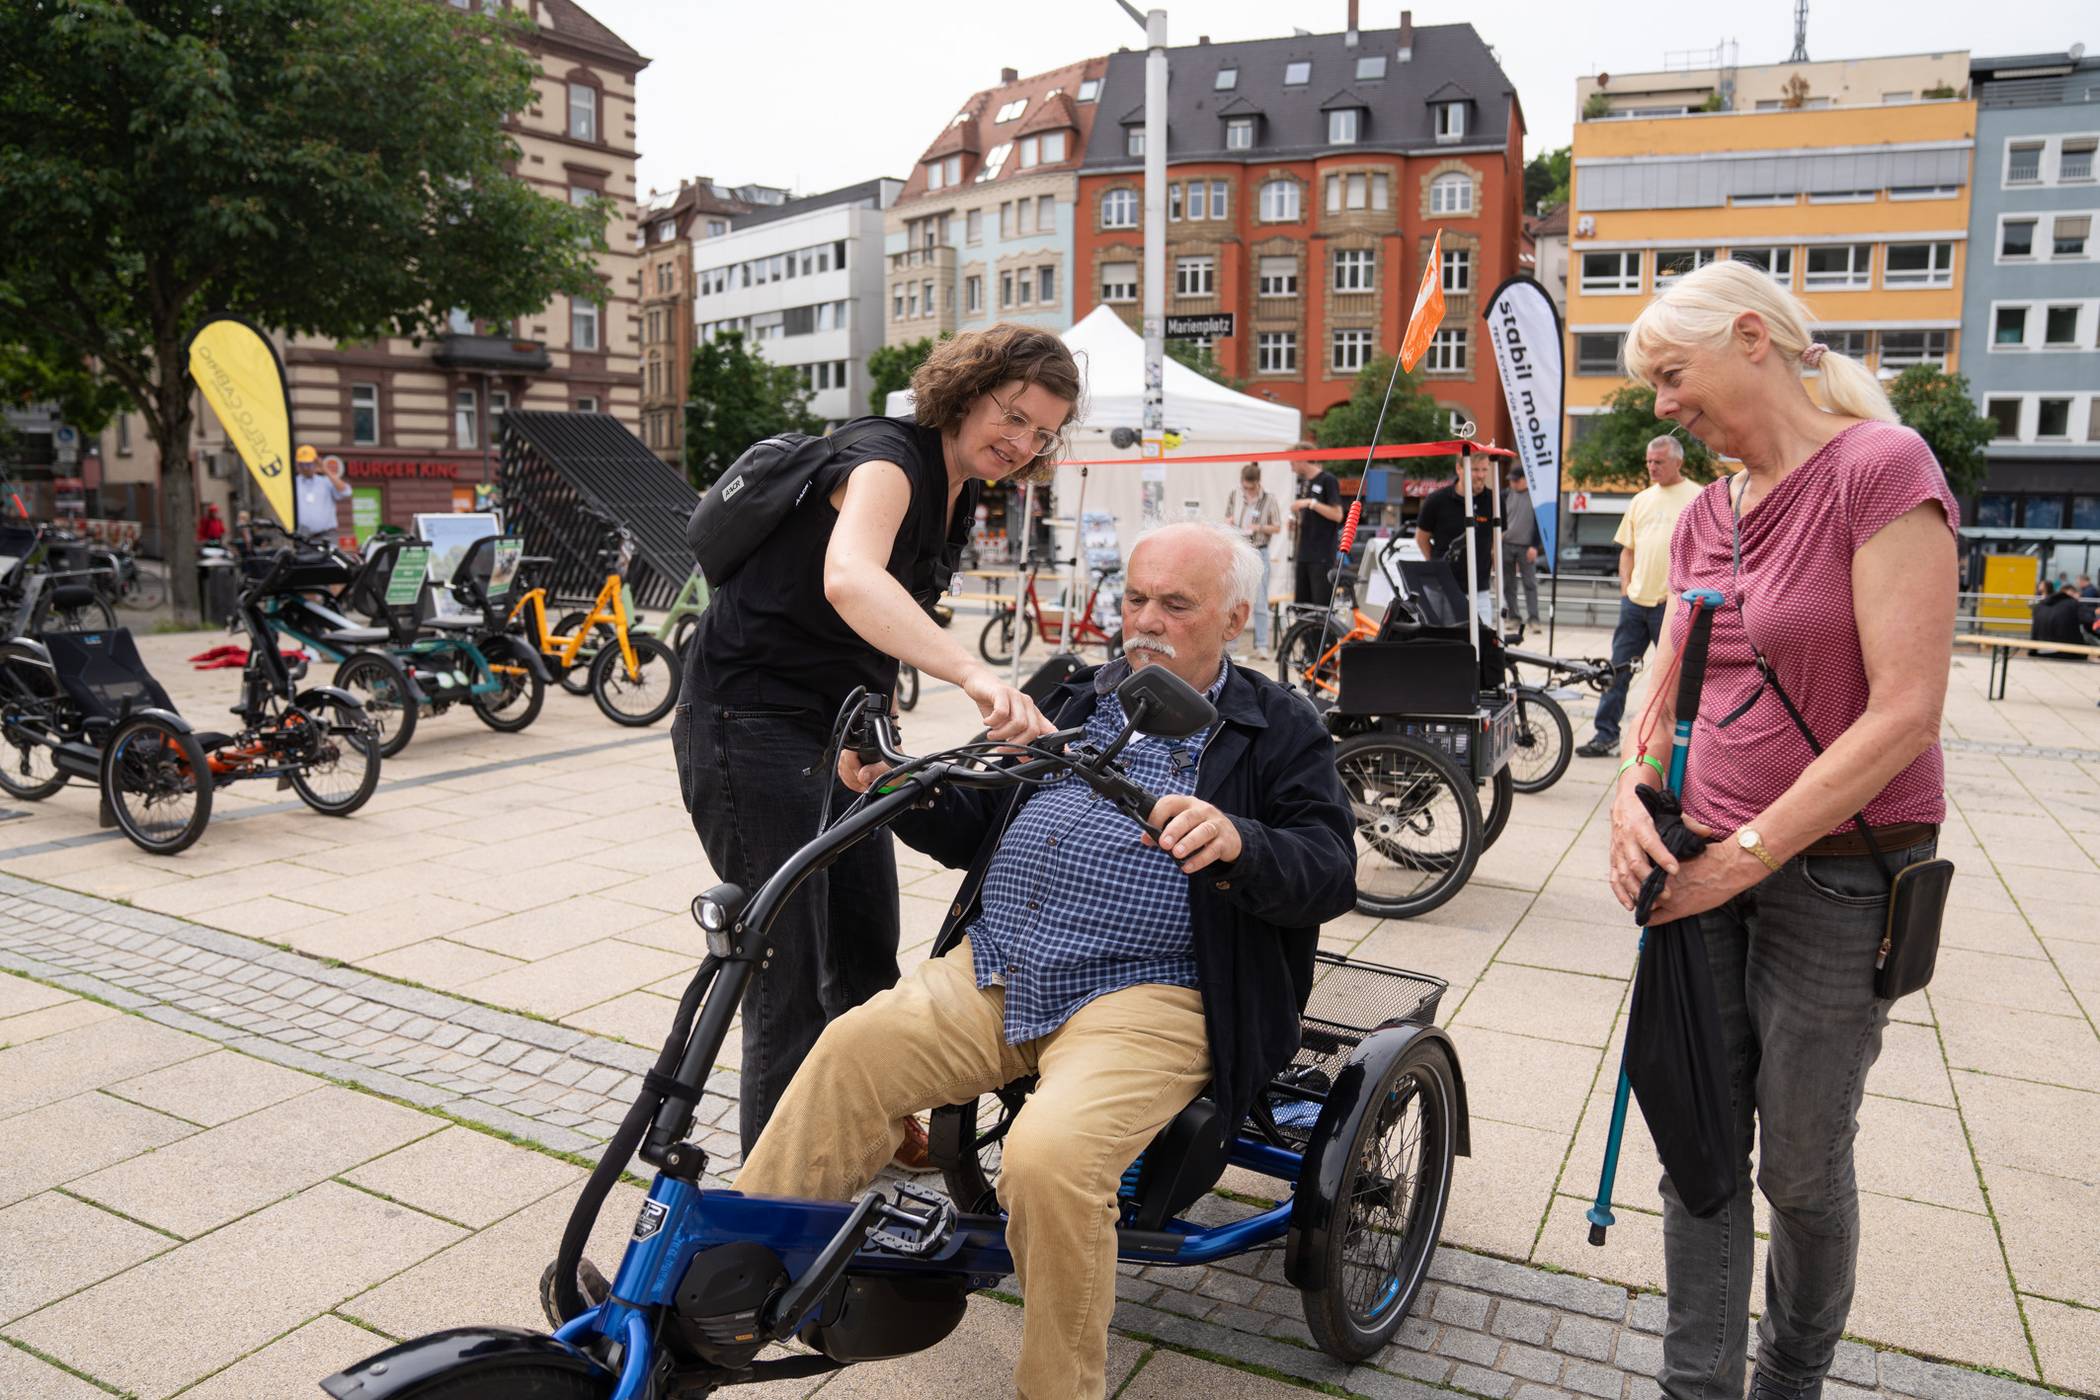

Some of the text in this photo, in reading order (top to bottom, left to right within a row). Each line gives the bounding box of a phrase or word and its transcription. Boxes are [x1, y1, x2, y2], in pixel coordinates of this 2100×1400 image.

[1167, 317, 1231, 336] Marienplatz
[1499, 300, 1553, 468] stabil mobil
[347, 460, 462, 478] BURGER KING
